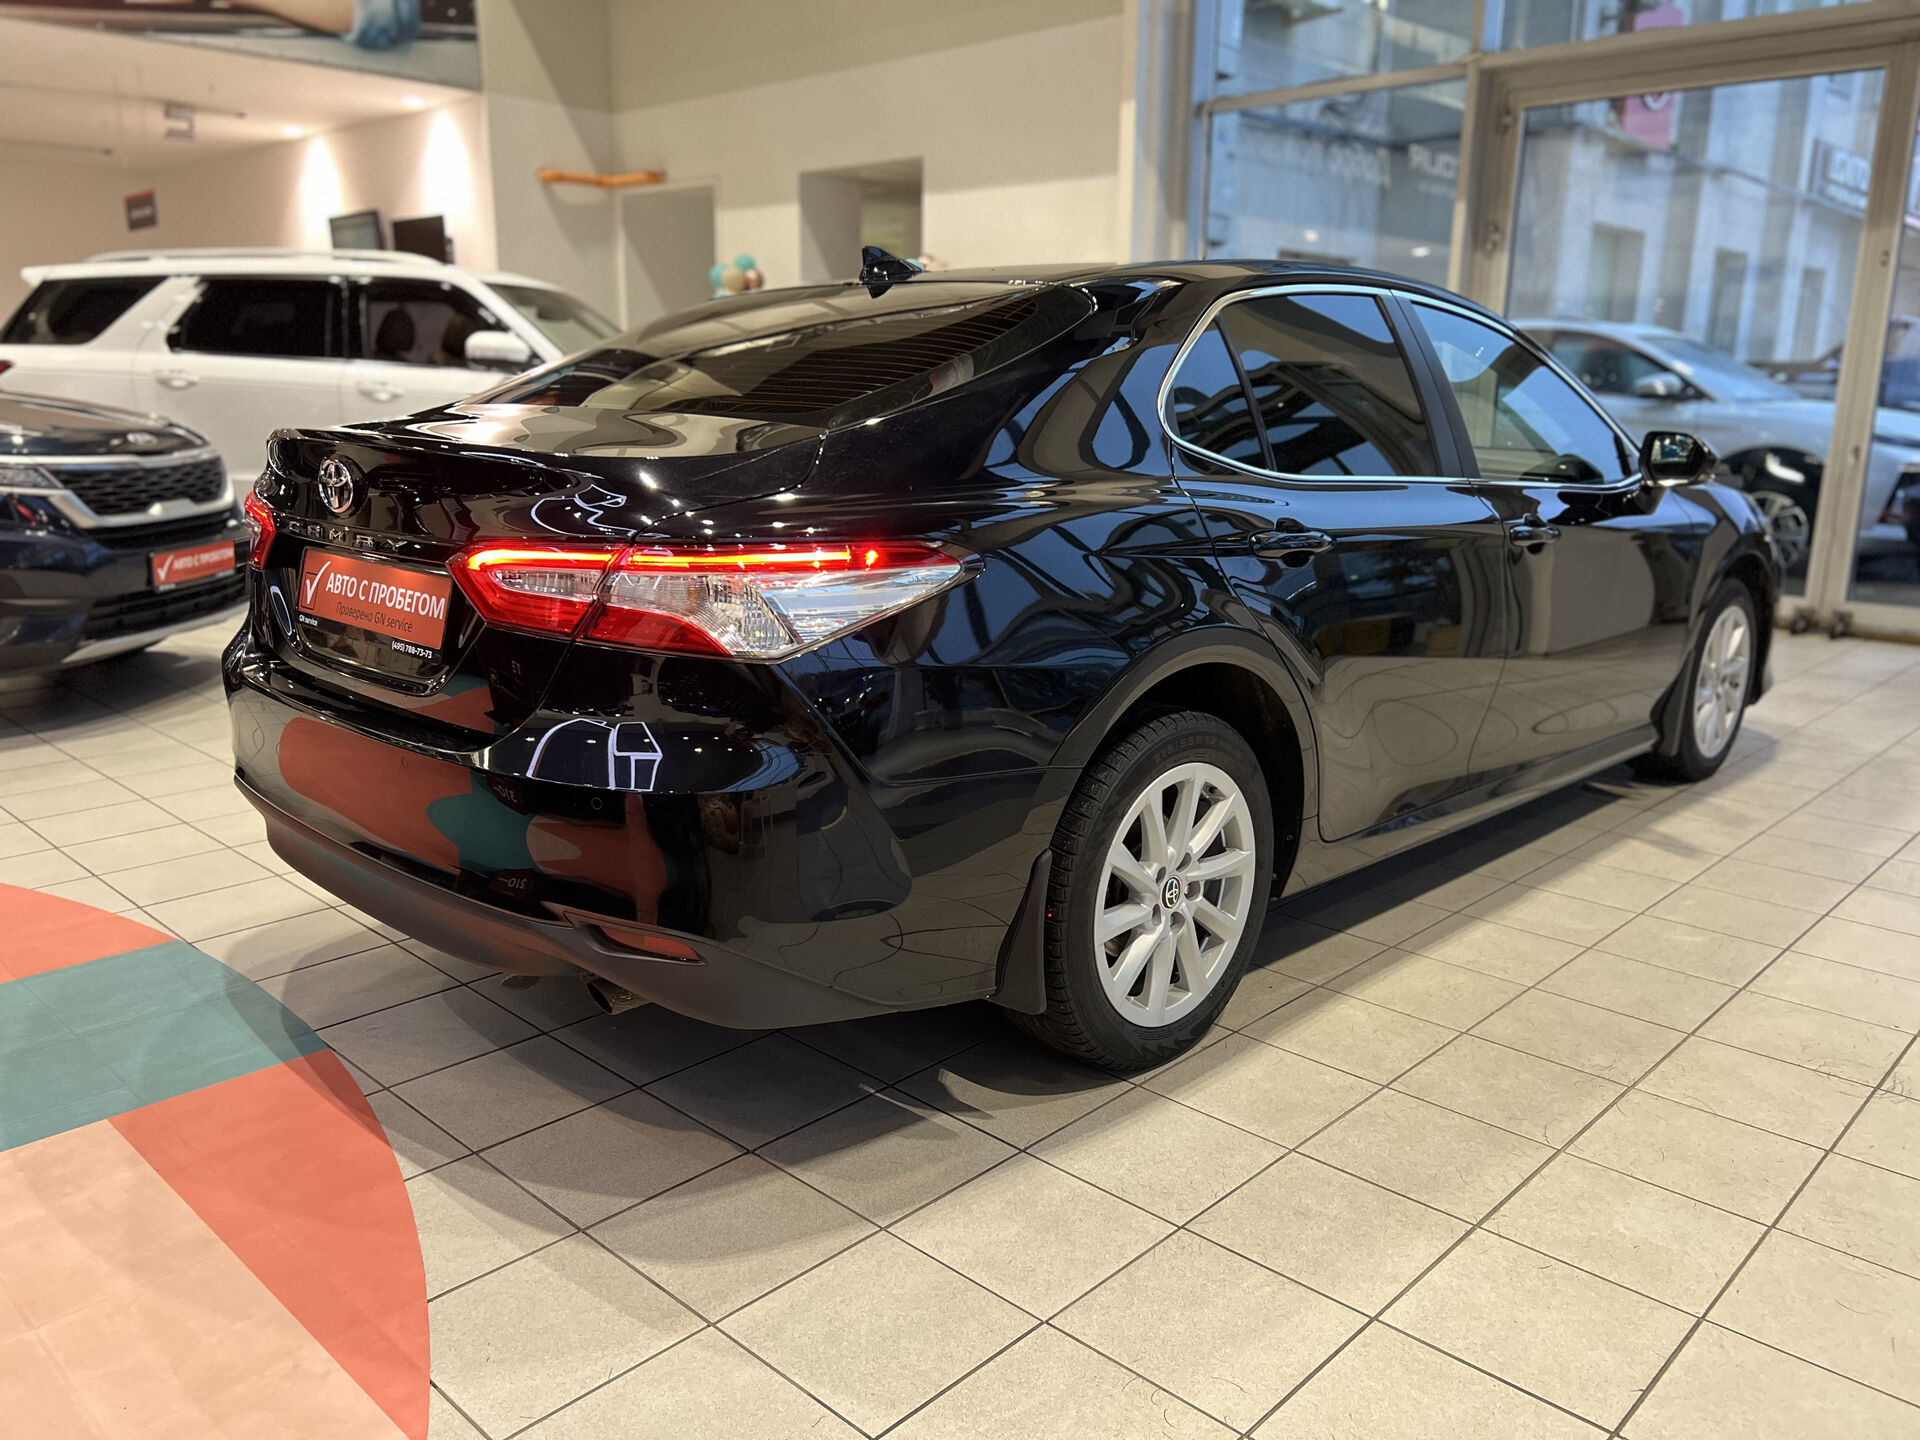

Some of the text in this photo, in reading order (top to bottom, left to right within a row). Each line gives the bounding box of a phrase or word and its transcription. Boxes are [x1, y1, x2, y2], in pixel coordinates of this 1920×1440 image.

[289, 521, 408, 550] CAMRY
[326, 572, 446, 620] АВТО С ПРОБЕГОМ
[336, 602, 413, 633] Проверено GN service
[392, 640, 406, 652] (495)
